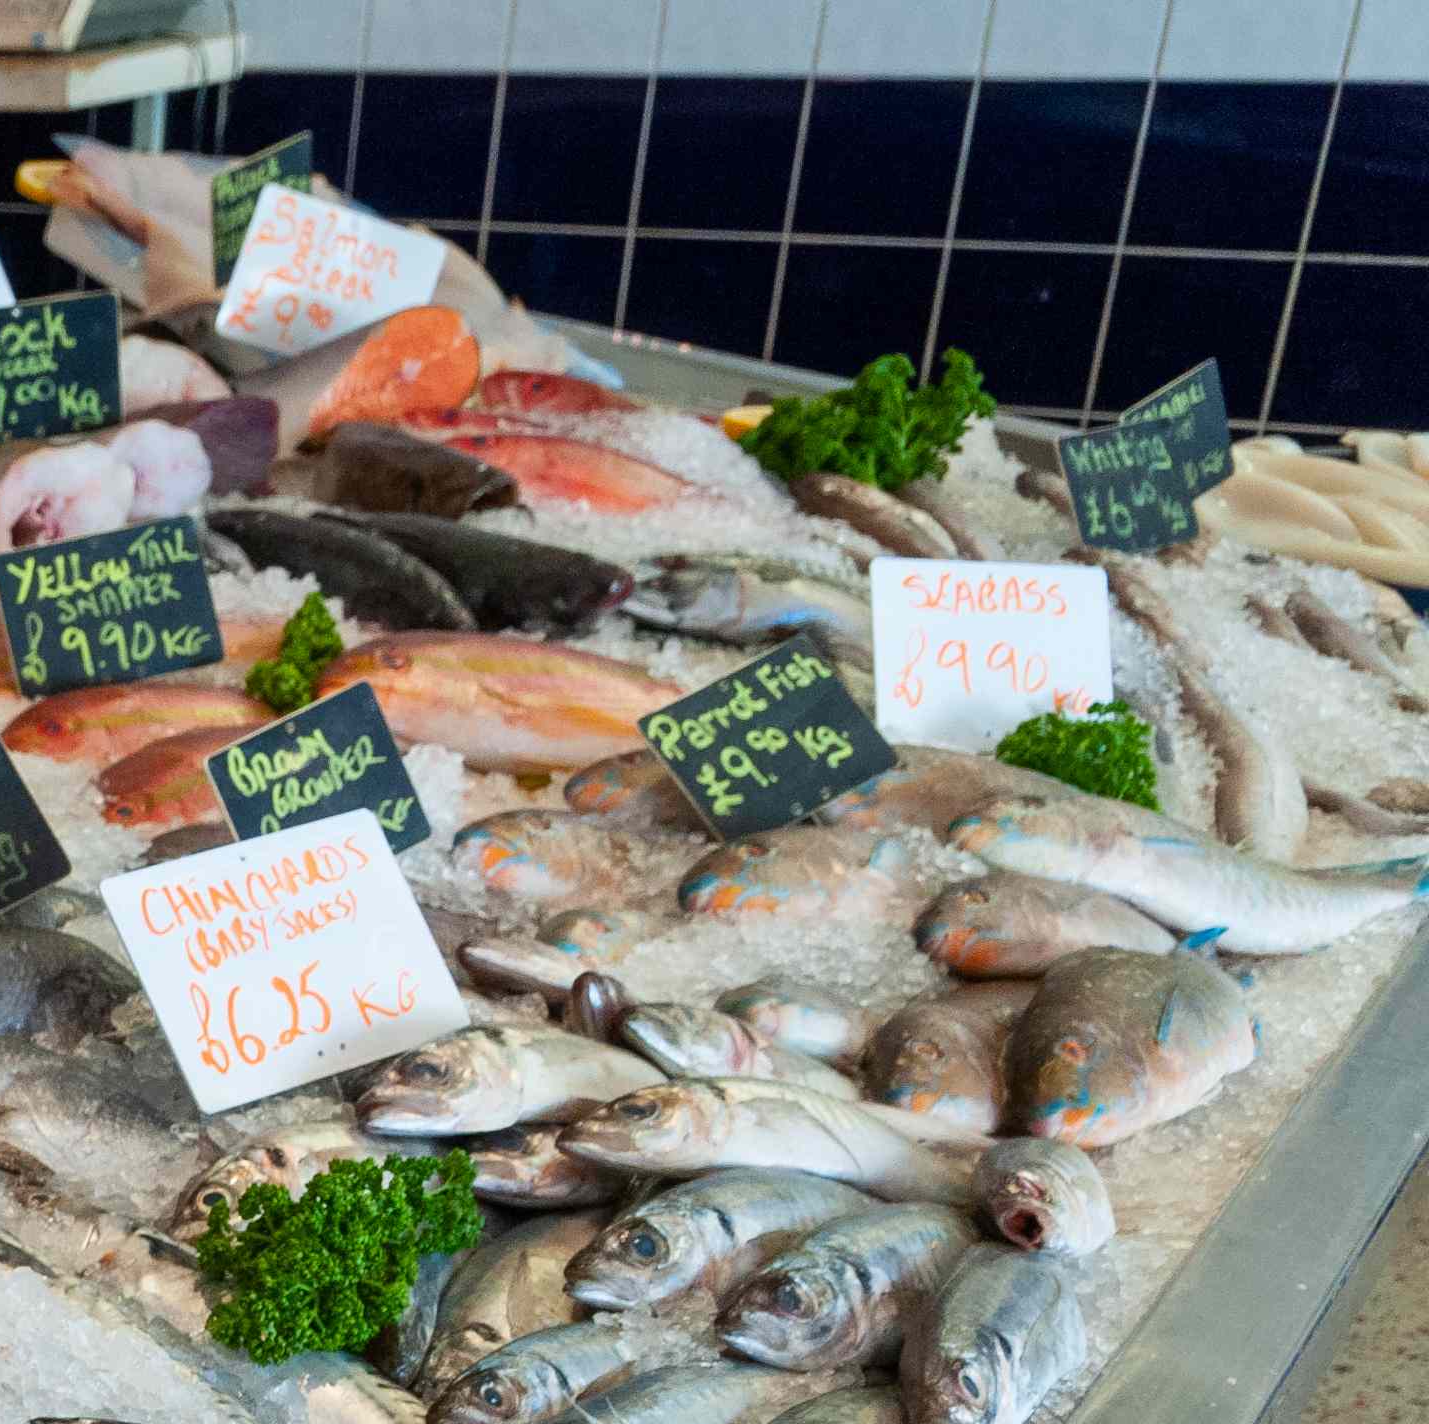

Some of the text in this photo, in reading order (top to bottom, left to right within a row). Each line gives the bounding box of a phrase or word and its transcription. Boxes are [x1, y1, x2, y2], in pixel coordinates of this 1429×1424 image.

[1067, 431, 1173, 475] Whiting
[902, 570, 1068, 617] SEABASS
[646, 651, 834, 763] Parrot Fish
